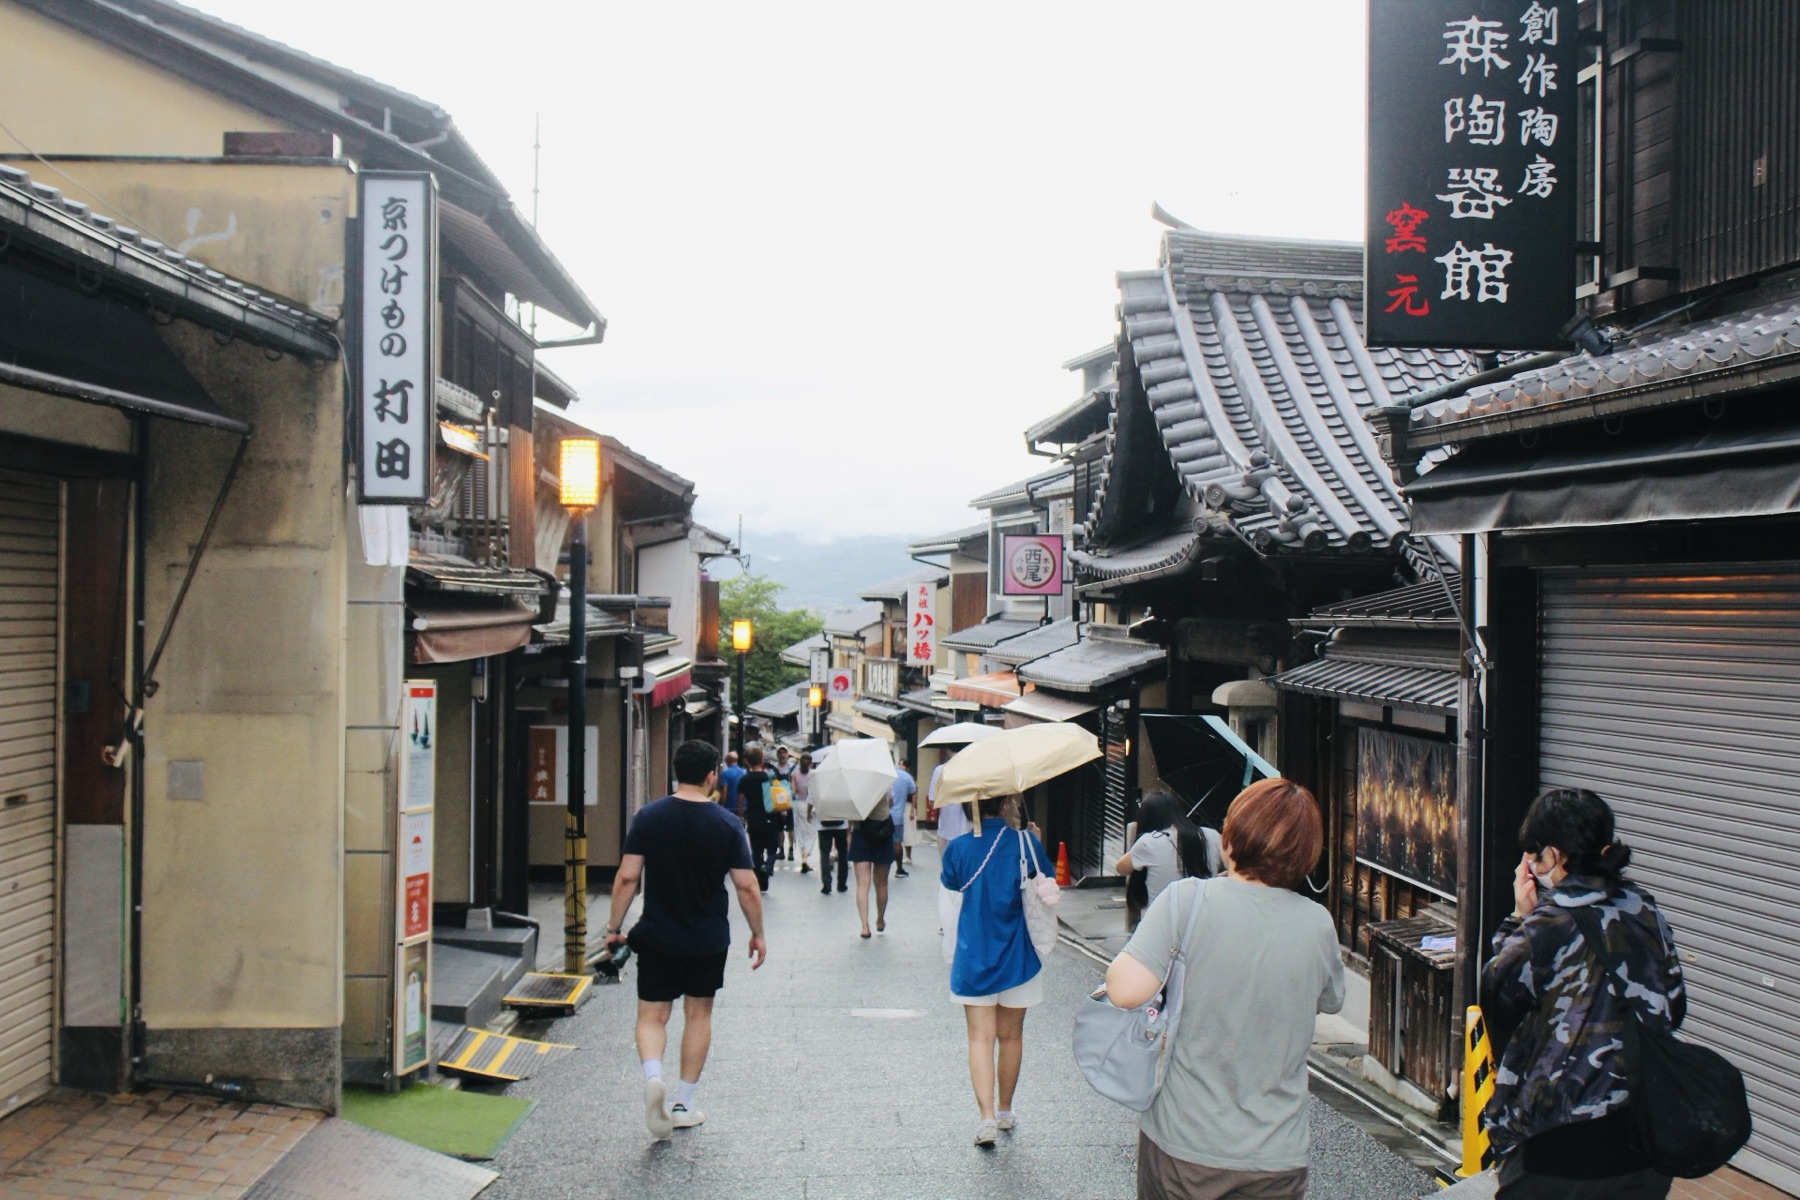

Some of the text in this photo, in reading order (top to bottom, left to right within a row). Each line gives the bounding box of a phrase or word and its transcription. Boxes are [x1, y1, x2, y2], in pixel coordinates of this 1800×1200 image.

[1434, 15, 1513, 303] 森陶器館
[1517, 0, 1558, 199] 創作陶房
[379, 197, 408, 357] 京つけもの
[1384, 201, 1430, 317] 窯元
[1023, 548, 1042, 582] 西尾
